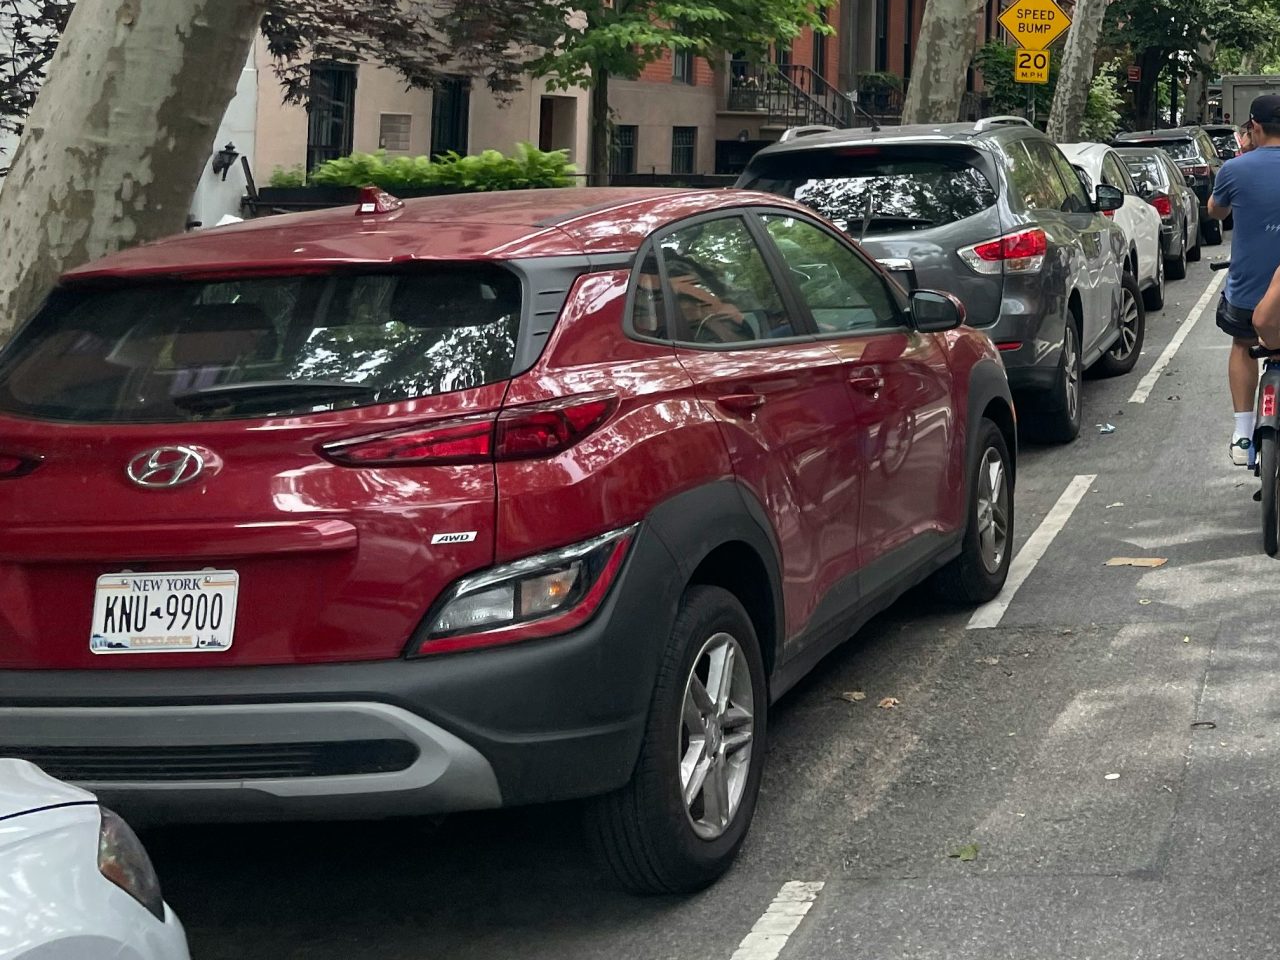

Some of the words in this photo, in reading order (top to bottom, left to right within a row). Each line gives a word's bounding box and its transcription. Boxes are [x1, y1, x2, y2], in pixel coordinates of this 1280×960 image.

[1016, 9, 1055, 21] SPEED
[1018, 22, 1051, 34] BUMP
[1019, 53, 1047, 70] 20
[437, 534, 470, 543] AWD
[132, 579, 164, 592] NEW
[166, 577, 202, 591] YORK
